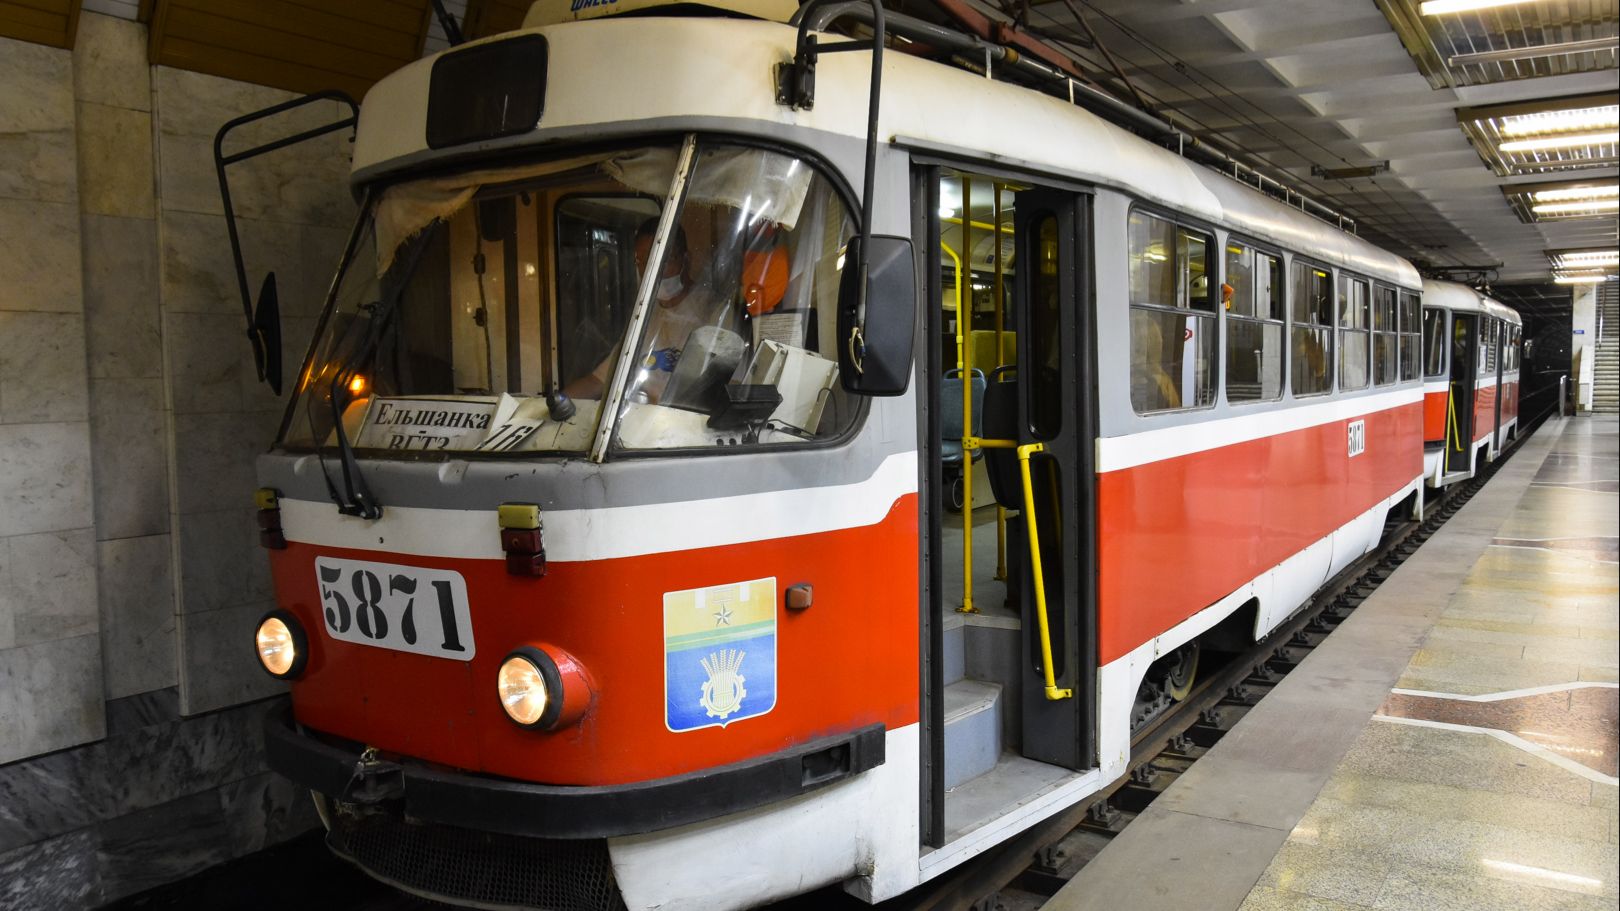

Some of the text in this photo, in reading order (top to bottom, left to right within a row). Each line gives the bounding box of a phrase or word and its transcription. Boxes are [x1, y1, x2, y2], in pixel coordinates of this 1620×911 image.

[374, 403, 492, 430] Ельшанка
[1348, 423, 1364, 454] 5871
[320, 565, 465, 652] 5871
